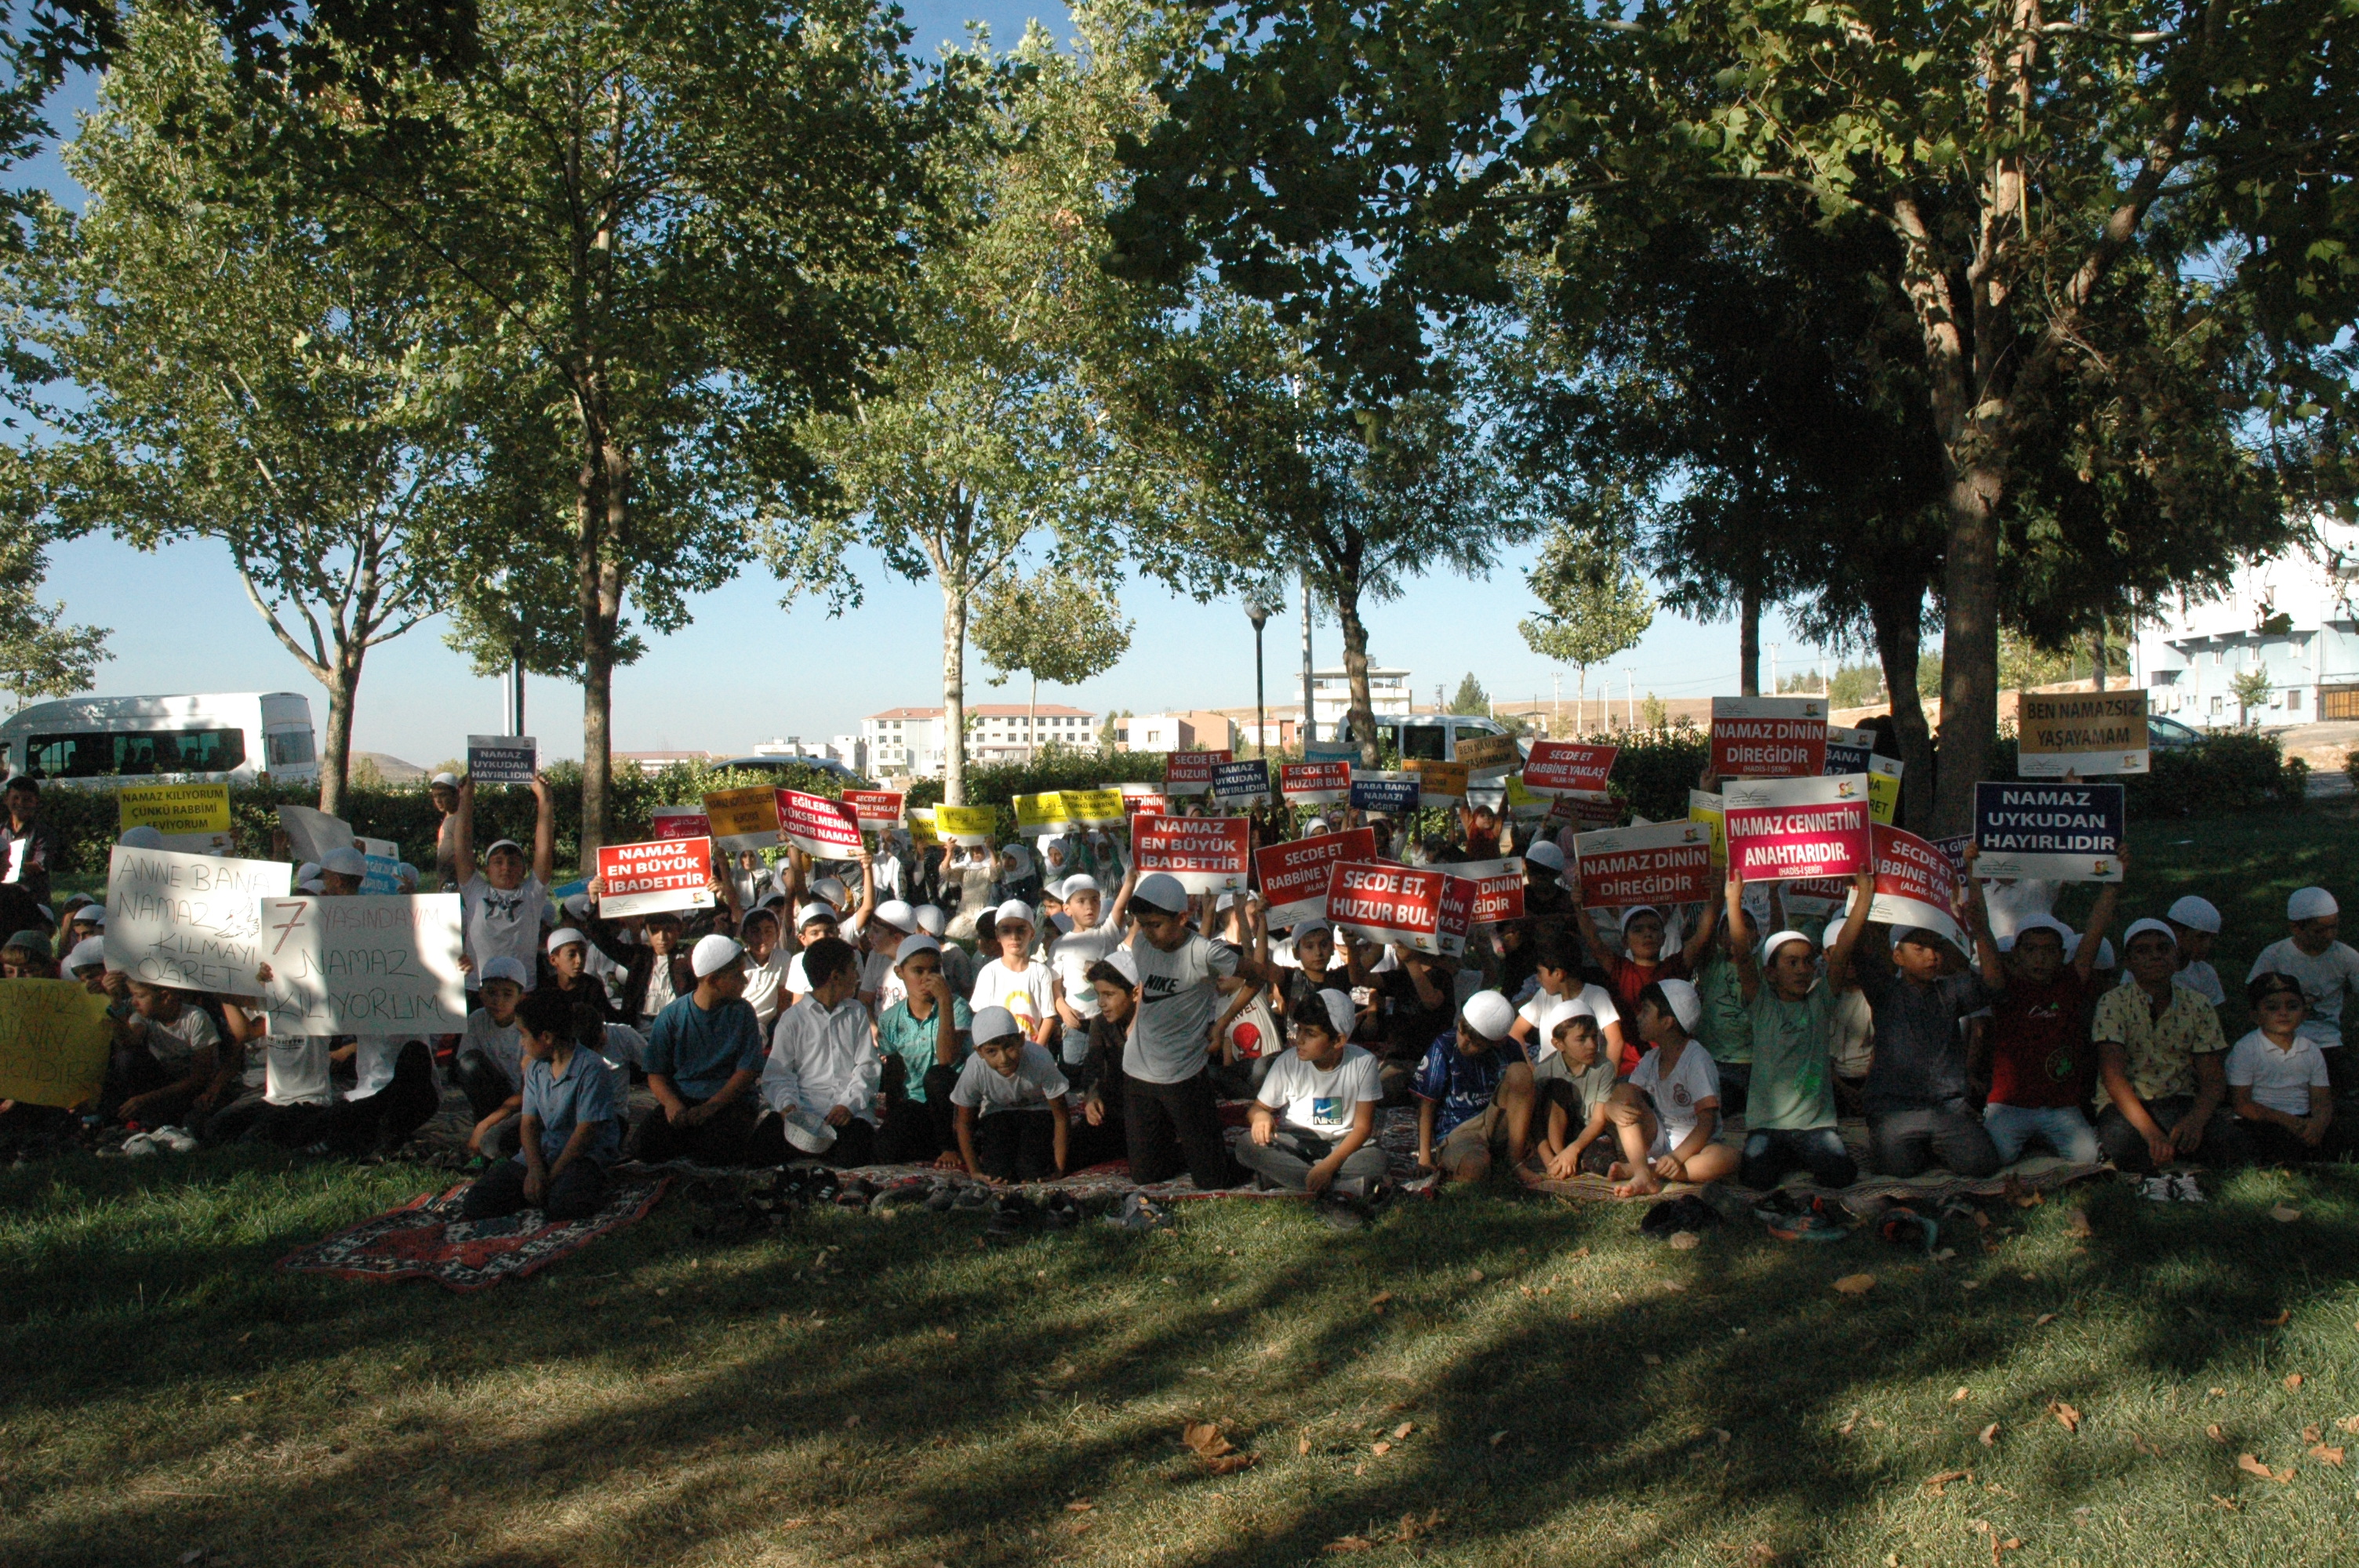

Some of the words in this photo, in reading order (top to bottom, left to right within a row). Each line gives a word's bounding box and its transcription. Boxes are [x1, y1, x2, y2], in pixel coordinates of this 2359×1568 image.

[2027, 702, 2055, 720] BEN
[2059, 698, 2142, 718] NAMAZSIZ
[1714, 723, 1773, 739] NAMAZ
[1776, 720, 1824, 740] DİNİN
[2037, 727, 2130, 752] YAŞAYAMAM
[481, 750, 522, 759] NAMAZ
[1175, 755, 1207, 765] SECDE
[1209, 753, 1223, 764] ET,
[1549, 750, 1579, 761] SECDE
[1580, 752, 1594, 761] ET
[1727, 744, 1808, 764] DİREĞİDİR
[473, 760, 529, 769] UYKUDAN
[1171, 769, 1208, 779] HUZUR
[1219, 763, 1255, 775] NAMAZ
[1289, 765, 1322, 776] SECDE
[1325, 764, 1339, 775] ET,
[1528, 762, 1569, 775] RABBİNE
[1569, 764, 1605, 780] YAKLAŞ
[471, 771, 533, 779] HAYIRLIDIR
[1215, 773, 1262, 786] UYKUDAN
[1285, 779, 1324, 789] HUZUR
[1325, 777, 1347, 787] BUL
[122, 792, 164, 802] NAMAZ
[165, 789, 224, 800] KILIYORUM
[1216, 783, 1267, 796] HAYIRLIDIR
[1364, 792, 1403, 801] NAMAZI
[2003, 791, 2091, 806] NAMAZ
[132, 804, 171, 819] ÇÜNKÜ
[173, 802, 217, 815] RABBİMİ
[791, 796, 839, 815] EĞİLEREK
[1368, 802, 1401, 812] ÖĞRET
[781, 806, 852, 831] YÜKSELMENİN
[1154, 819, 1225, 834] NAMAZ
[1730, 815, 1784, 837] NAMAZ
[1786, 807, 1860, 834] CENNETİN
[1988, 812, 2106, 829] UYKUDAN
[783, 820, 816, 836] ADIDIR
[817, 828, 858, 844] NAMAZ
[619, 843, 687, 860] NAMAZ
[1141, 837, 1165, 850] EN
[1171, 837, 1236, 852] BÜYÜK
[1983, 834, 2115, 851] HAYIRLIDIR
[1140, 852, 1239, 869] İBADETTİR
[1285, 846, 1325, 866] SECDE
[1328, 843, 1343, 857] ET
[1583, 854, 1651, 876] NAMAZ
[1654, 848, 1707, 869] DİNİN
[1745, 842, 1851, 867] ANAHTARIDIR.
[1892, 840, 1937, 870] SECDE
[1939, 863, 1953, 880] ET
[118, 854, 182, 888] ANNE
[191, 864, 271, 898] BANA
[607, 864, 631, 877] EN
[636, 856, 700, 874] BÜYÜK
[609, 872, 705, 893] İBADETTİR
[1267, 868, 1321, 891] RABBİNE
[1343, 870, 1399, 894] SECDE
[1401, 876, 1427, 899] ET,
[1481, 877, 1521, 895] DİNİN
[1601, 873, 1692, 896] DİREĞİDİR
[118, 891, 220, 931] NAMAZ
[1332, 897, 1393, 923] HUZUR
[1397, 904, 1430, 927] BUL
[272, 902, 308, 956] 7
[148, 931, 256, 966] KILMAYI
[138, 952, 242, 991] ÖĞRET
[294, 949, 420, 979] NAMAZ
[1144, 974, 1179, 993] NIKE
[268, 987, 447, 1023] KILIYORUM
[1314, 1116, 1342, 1124] NIKE
